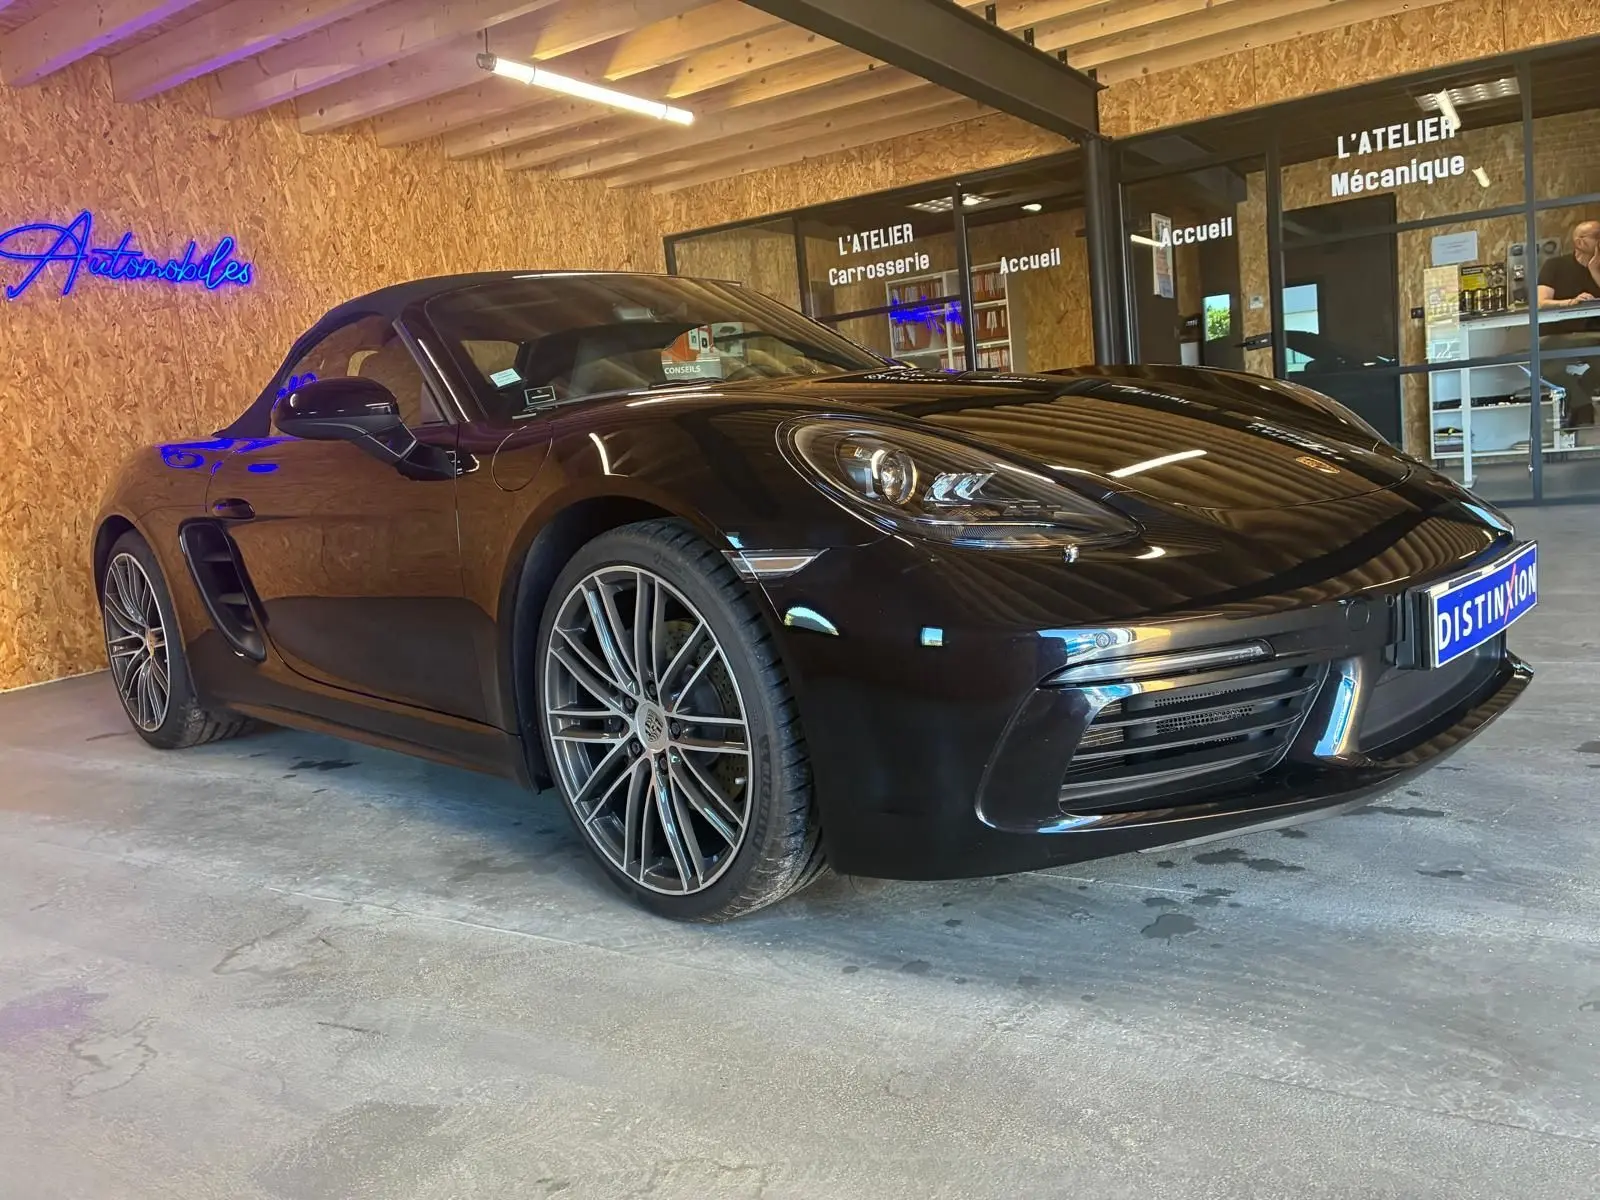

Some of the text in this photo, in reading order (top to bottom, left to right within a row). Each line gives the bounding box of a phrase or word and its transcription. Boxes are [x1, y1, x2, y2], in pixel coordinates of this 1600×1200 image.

[1337, 115, 1455, 159] L'ATELIER
[1331, 155, 1465, 197] Mécanique
[838, 223, 914, 256] L'ATELIER
[1160, 216, 1233, 248] Accueil
[0, 210, 252, 298] Automobiles
[828, 252, 930, 286] Carrosserie
[999, 247, 1061, 275] Accueil
[664, 365, 701, 375] CONSEILS
[1438, 562, 1537, 651] DISTINXION
